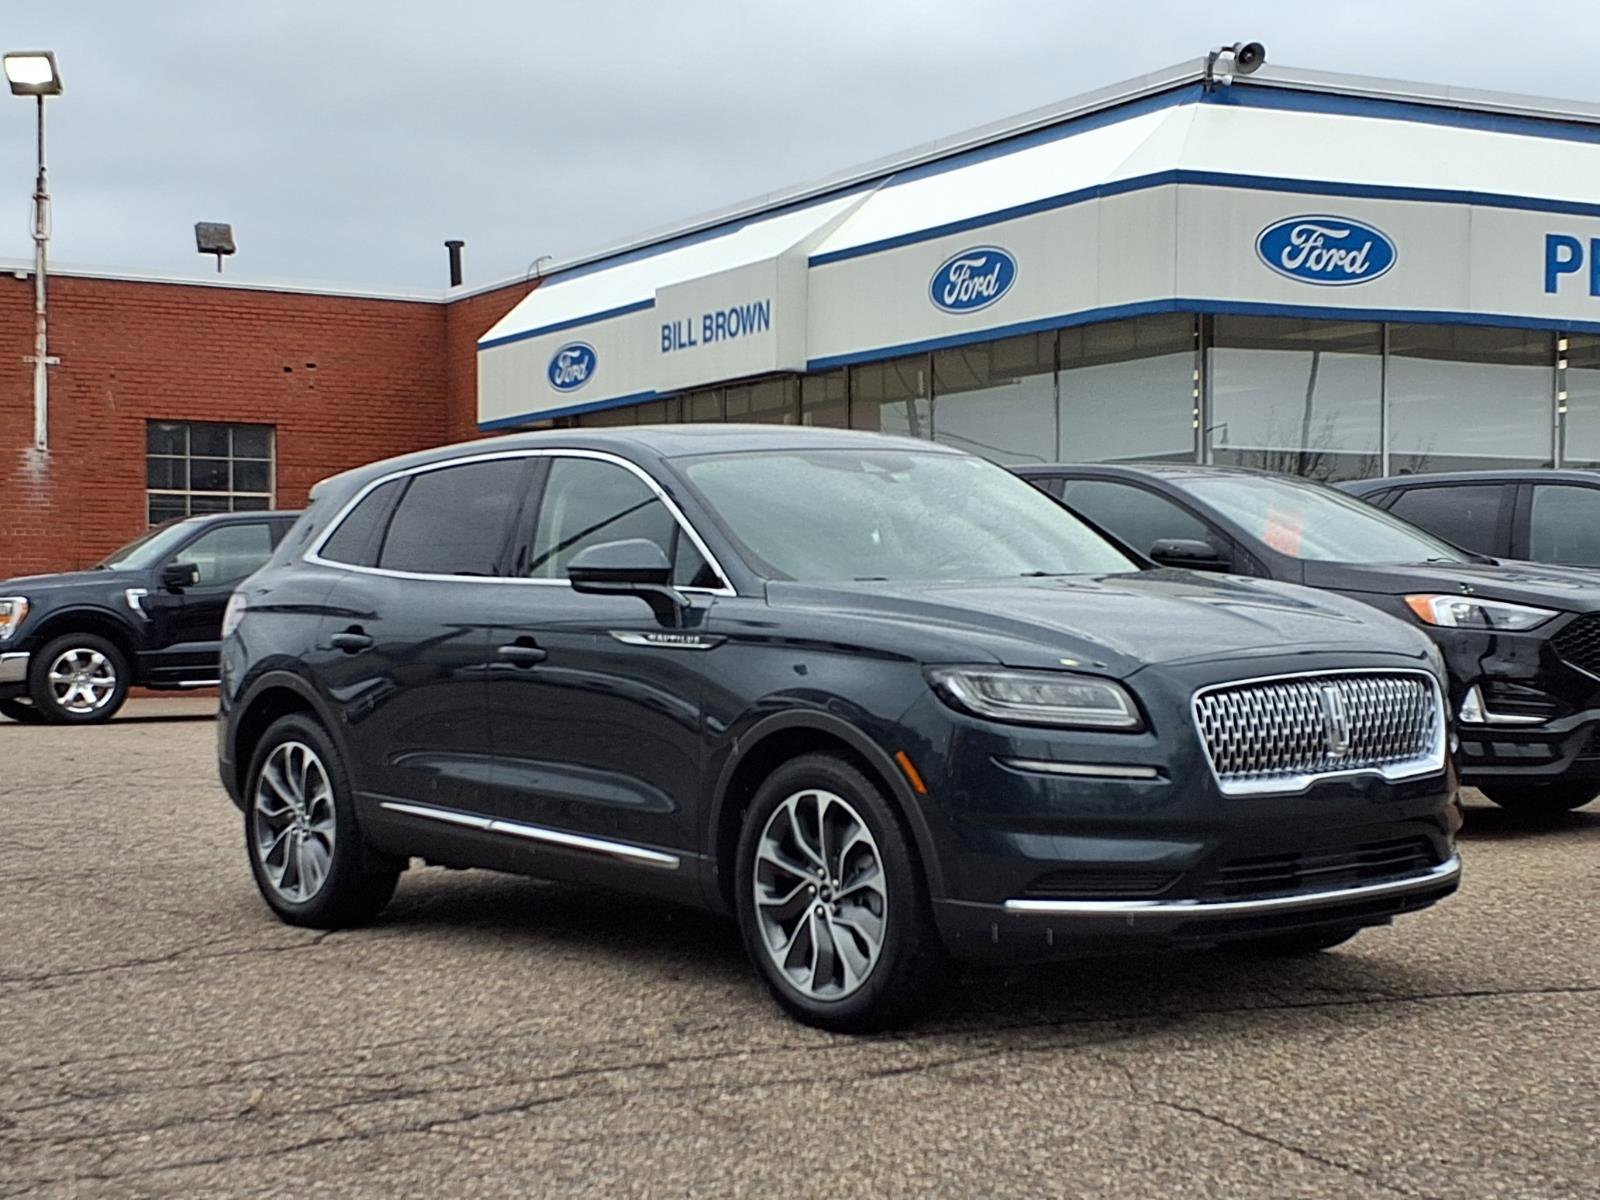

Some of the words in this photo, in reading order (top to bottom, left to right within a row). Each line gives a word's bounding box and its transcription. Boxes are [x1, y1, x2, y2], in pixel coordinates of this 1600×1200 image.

[1281, 224, 1373, 274] Ford
[944, 256, 1002, 305] Ford
[661, 319, 697, 353] BILL
[703, 299, 771, 344] BROWN
[554, 350, 589, 385] Ford
